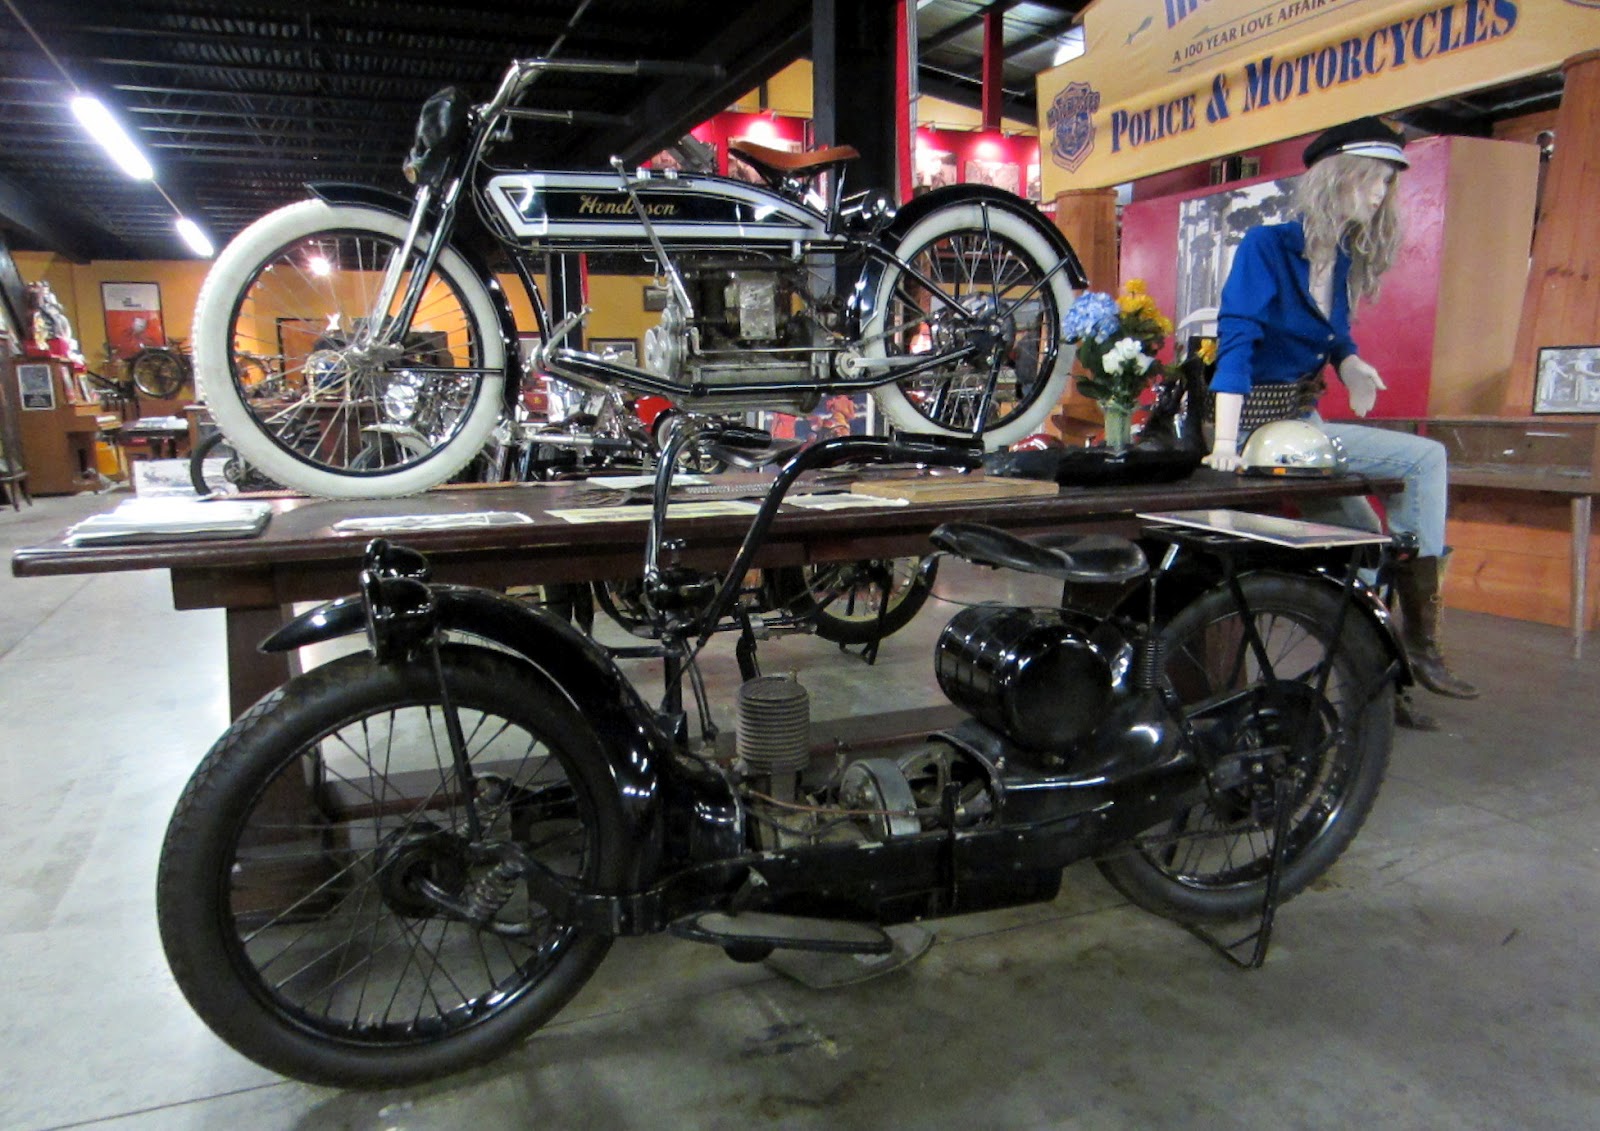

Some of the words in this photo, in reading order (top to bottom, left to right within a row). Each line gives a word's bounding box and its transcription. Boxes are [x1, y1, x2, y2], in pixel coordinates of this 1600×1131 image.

[1172, 51, 1182, 64] A
[1184, 41, 1203, 60] 100
[1206, 28, 1237, 50] YEAR
[1240, 15, 1274, 37] LOVE
[1206, 74, 1230, 124] &
[1242, 0, 1517, 113] MOTORCYCLES
[578, 194, 678, 216] Hendeson
